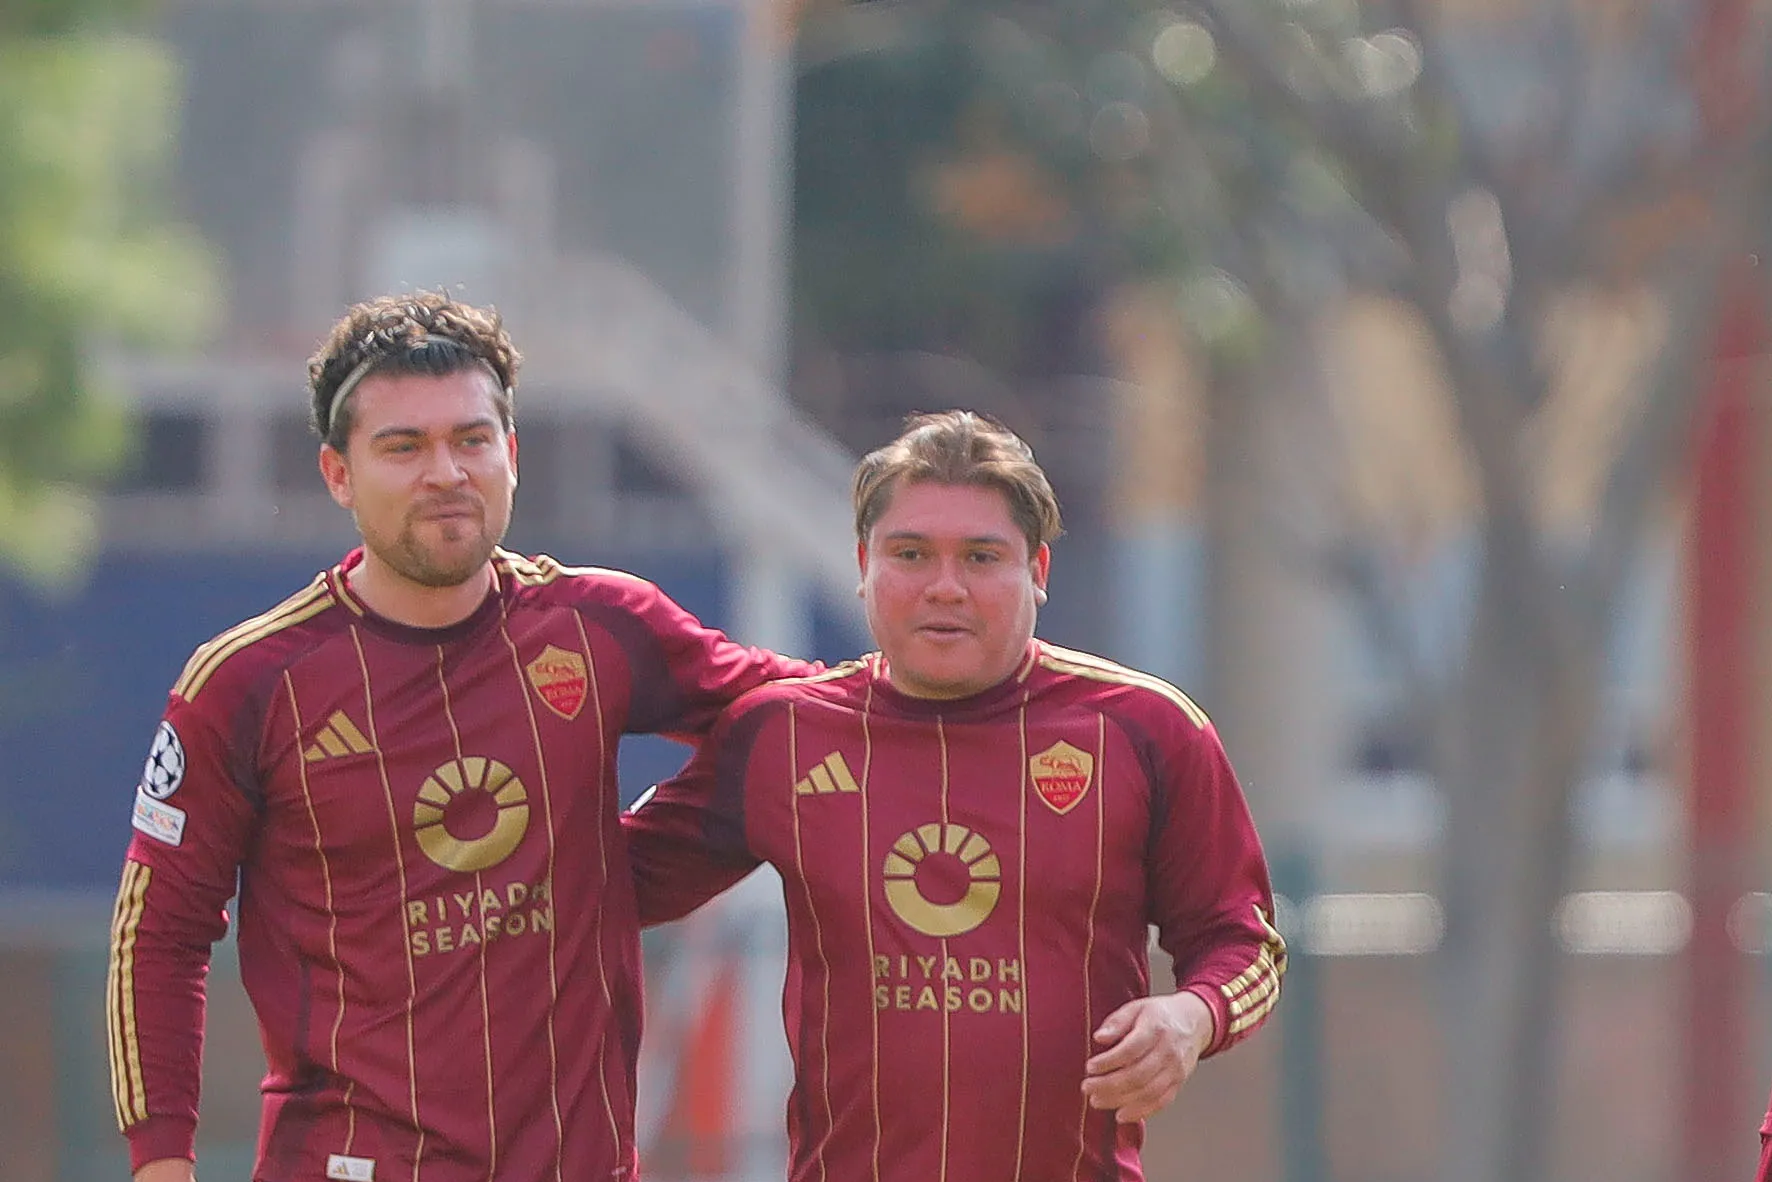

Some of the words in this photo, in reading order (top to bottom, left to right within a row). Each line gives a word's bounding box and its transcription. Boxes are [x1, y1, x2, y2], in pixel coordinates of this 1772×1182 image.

[411, 907, 552, 956] SEASON
[874, 954, 1021, 982] RIYADH
[875, 985, 1022, 1013] SEASON
